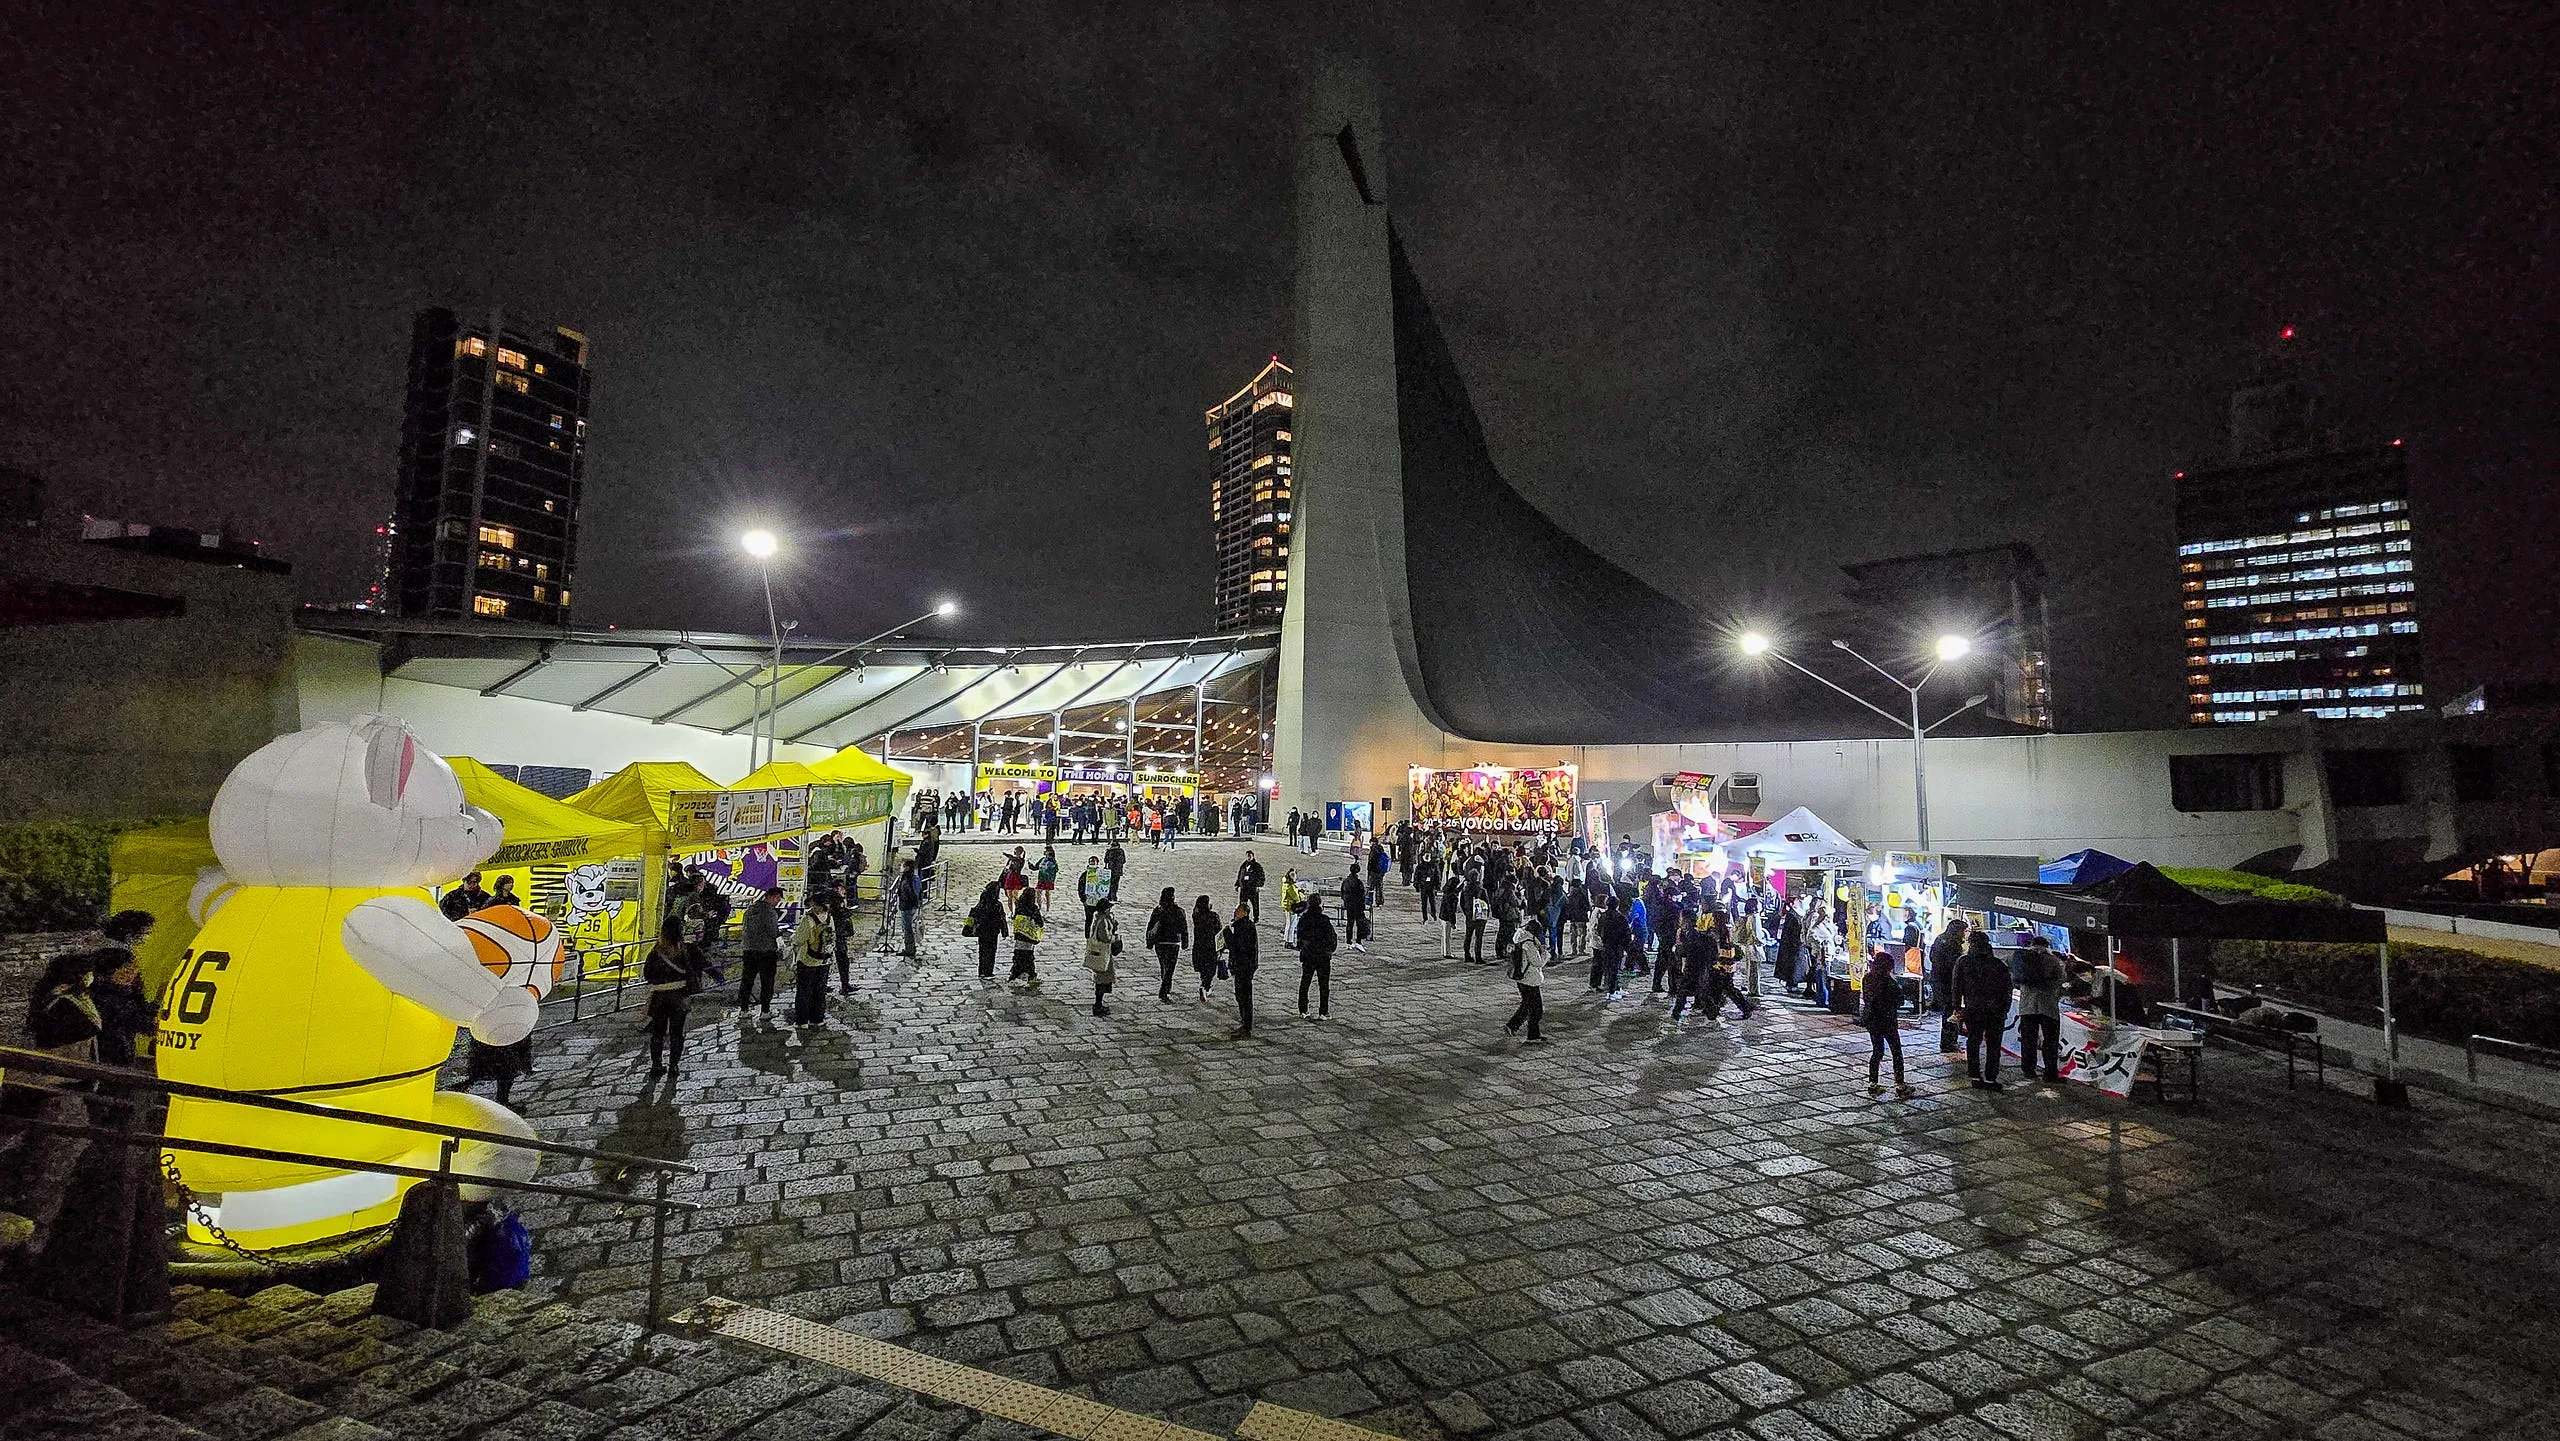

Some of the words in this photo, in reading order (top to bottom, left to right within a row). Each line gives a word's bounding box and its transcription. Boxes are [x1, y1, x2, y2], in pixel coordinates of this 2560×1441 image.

[984, 767, 1036, 777] WELCOME
[1040, 769, 1055, 777] TO
[1064, 770, 1084, 779] THE
[1086, 771, 1115, 780] HOME
[1116, 773, 1130, 781] OF
[1138, 774, 1198, 784] SUNROCKERS
[1460, 817, 1508, 830] YOYOGI
[1511, 818, 1559, 832] GAMES
[584, 919, 601, 932] 36
